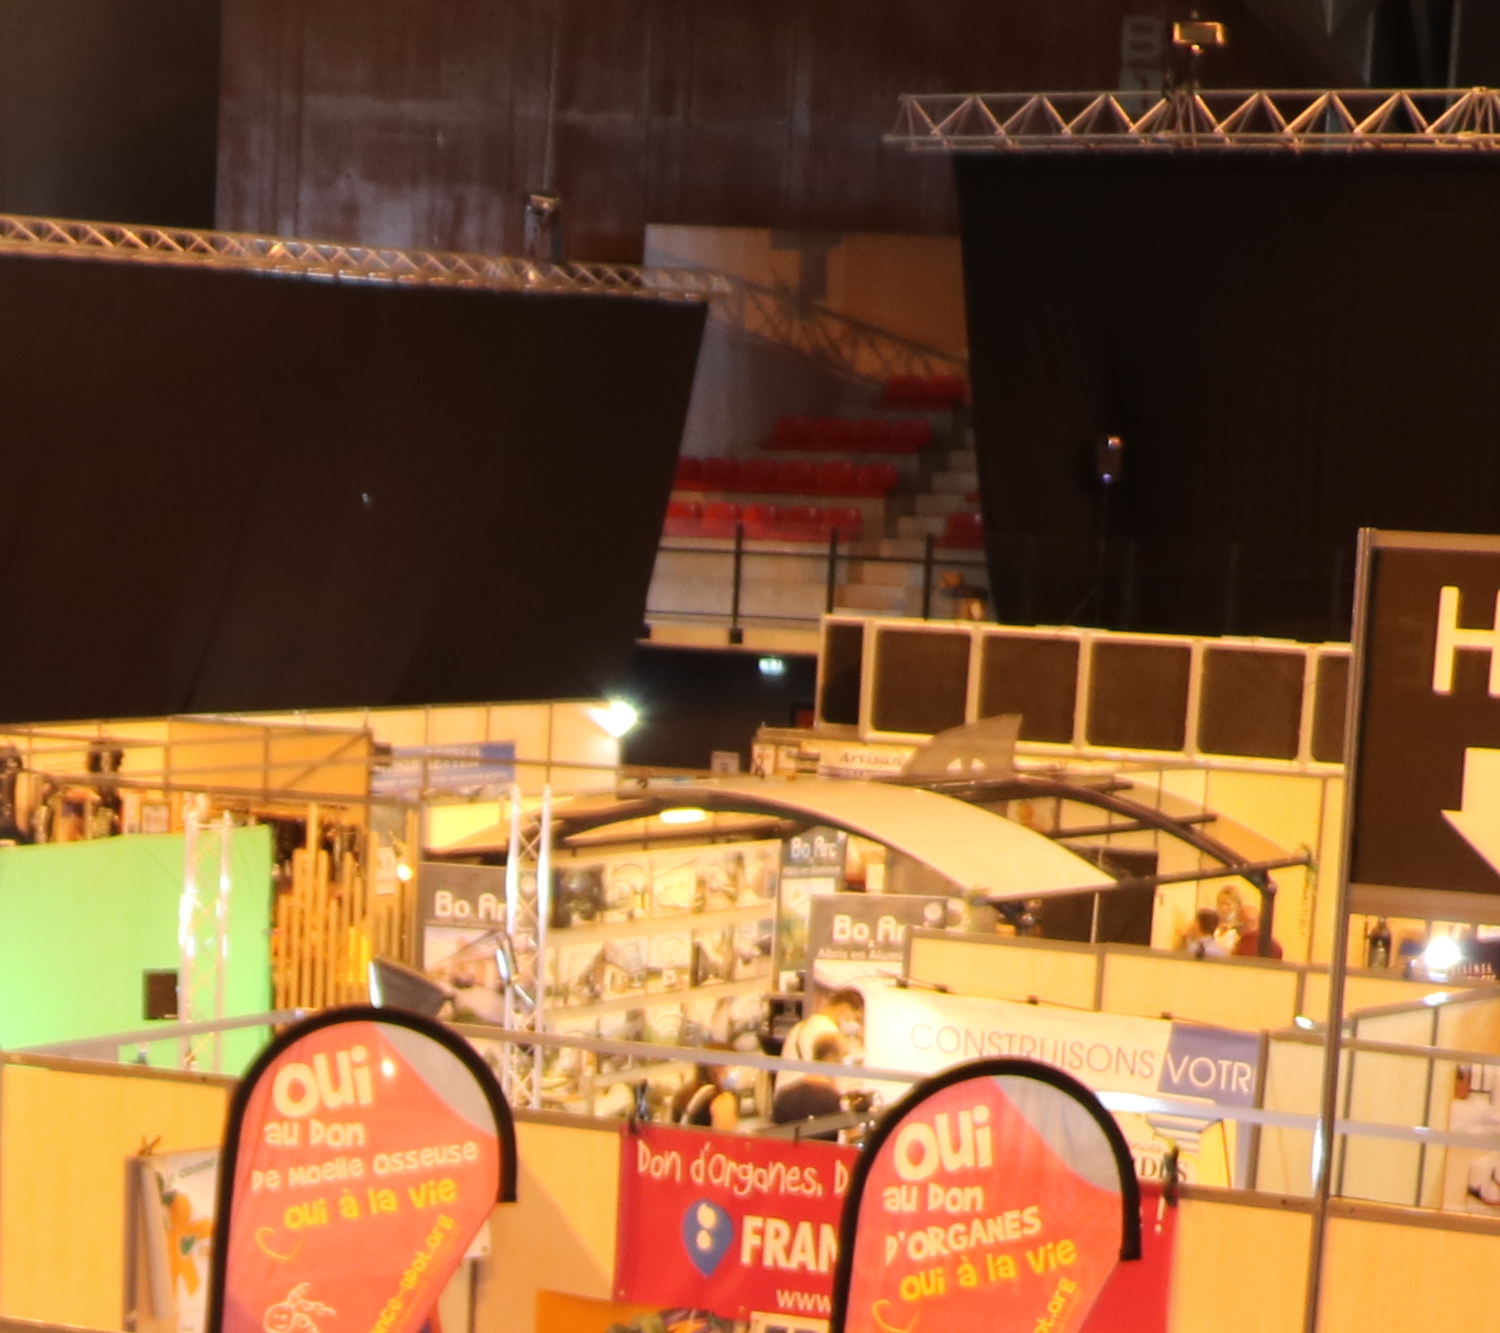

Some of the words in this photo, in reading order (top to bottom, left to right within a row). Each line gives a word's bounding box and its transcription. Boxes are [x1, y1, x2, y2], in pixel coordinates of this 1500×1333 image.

[434, 890, 470, 919] Bo
[833, 915, 870, 944] Bo
[910, 1023, 1156, 1080] CONSTRUISONS
[1165, 1050, 1258, 1094] VOTR
[636, 1142, 682, 1180] Don
[740, 1215, 838, 1272] FRAN
